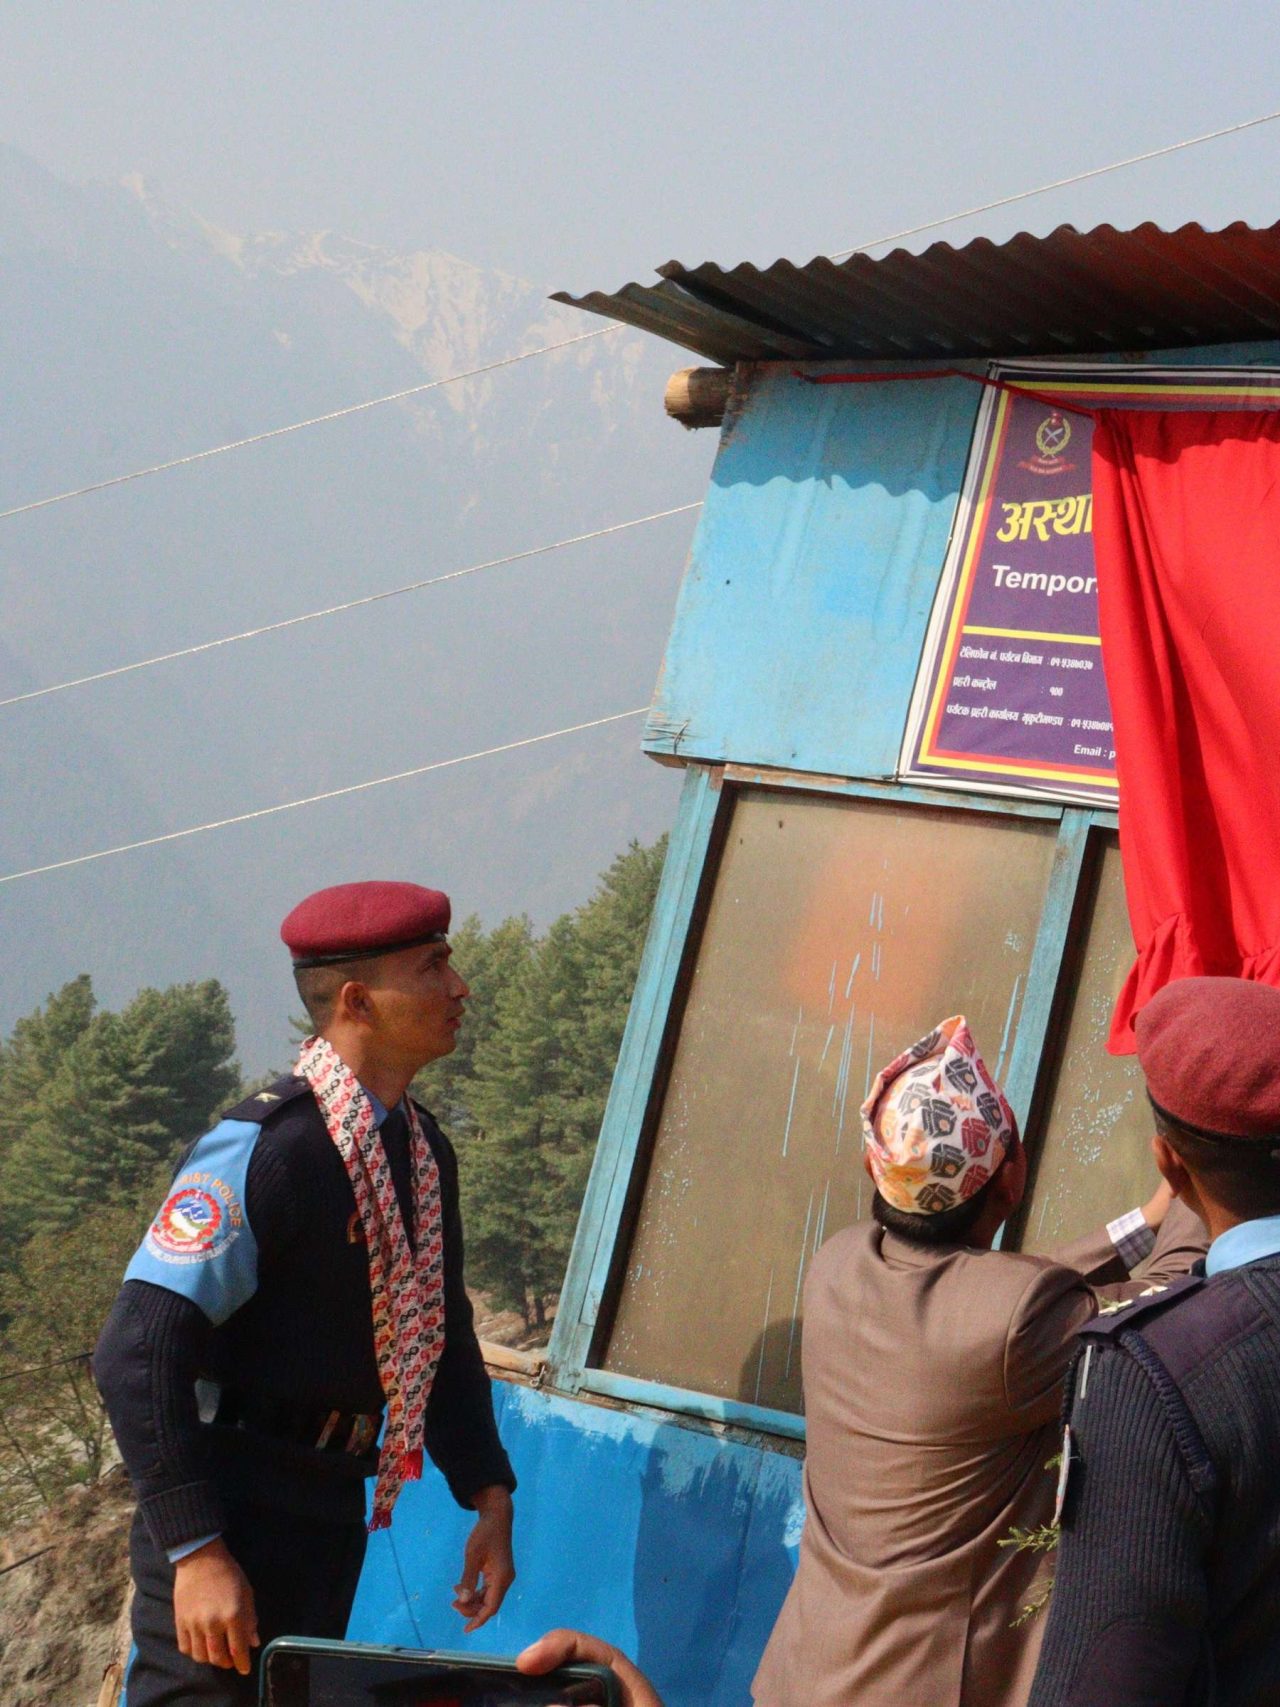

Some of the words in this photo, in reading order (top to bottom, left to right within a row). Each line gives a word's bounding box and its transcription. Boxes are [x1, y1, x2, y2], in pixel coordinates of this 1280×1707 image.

[992, 564, 1098, 597] Tempor
[1073, 744, 1102, 757] Email
[211, 1178, 241, 1227] POLICE
